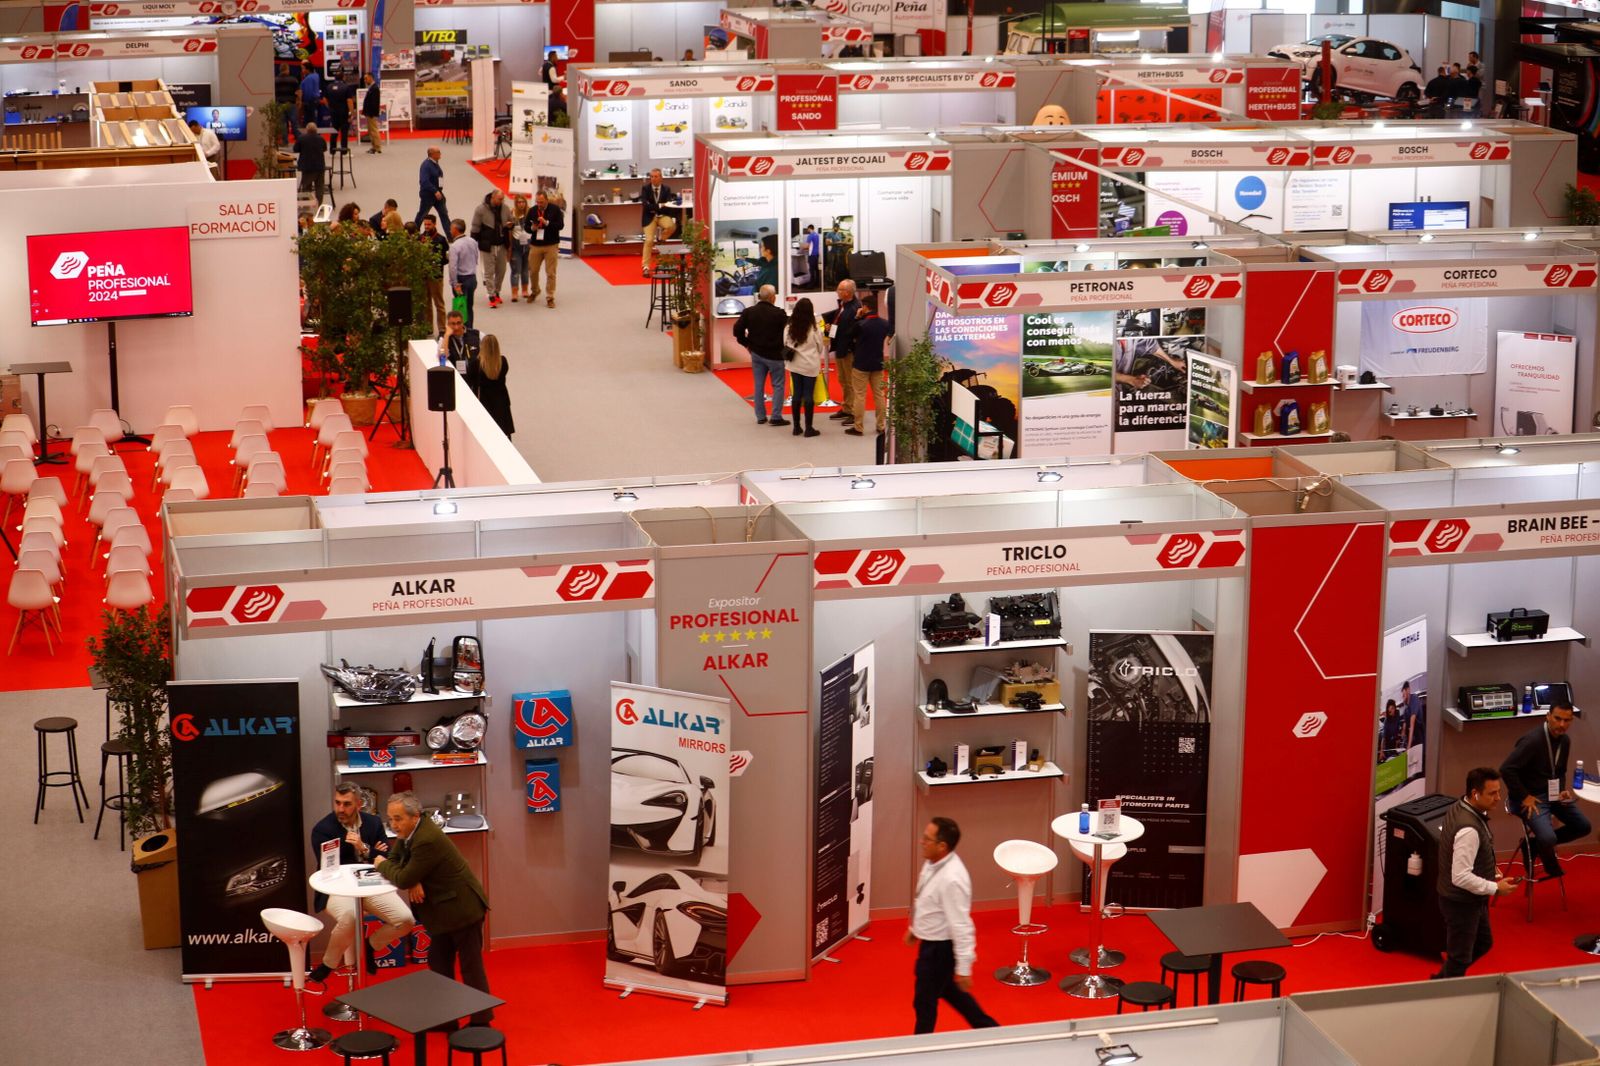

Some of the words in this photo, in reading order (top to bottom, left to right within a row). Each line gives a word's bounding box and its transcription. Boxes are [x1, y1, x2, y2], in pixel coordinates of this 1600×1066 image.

[851, 2, 890, 14] Grupo
[894, 1, 927, 12] Peña
[422, 31, 457, 43] VTEQ
[603, 103, 627, 112] Sando
[664, 100, 690, 111] Sando
[724, 97, 747, 108] Sando
[1191, 150, 1223, 158] BOSCH
[1398, 146, 1429, 154] BOSCH
[796, 157, 835, 166] JALTEST
[851, 156, 885, 164] COJALI
[1052, 171, 1088, 181] EMIUM
[1052, 194, 1080, 203] OSCH
[219, 204, 252, 216] SALA
[257, 203, 276, 215] DE
[191, 218, 276, 235] FORMACIÓN
[87, 262, 125, 278] PEÑA
[1444, 269, 1497, 280] CORTECO
[88, 274, 171, 290] PROFESIONAL
[1070, 281, 1134, 293] PETRONAS
[88, 290, 119, 302] 2024
[947, 318, 992, 326] NOSOTROS
[1027, 315, 1051, 325] Cool
[1399, 313, 1450, 327] CORTECO
[951, 325, 1008, 333] CONDICIONES
[1026, 325, 1077, 337] conseguir
[935, 334, 952, 342] MÁS
[953, 333, 996, 341] EXTREMAS
[1026, 339, 1046, 347] con
[1048, 337, 1082, 346] menos
[1510, 363, 1545, 372] OFRECEMOS
[1517, 371, 1560, 381] TRANQUILIDAD
[1119, 391, 1133, 401] La
[1135, 390, 1171, 401] fuerza
[1119, 404, 1145, 415] para
[1147, 402, 1187, 412] marcar
[1119, 416, 1129, 426] la
[1132, 414, 1187, 425] diferencia
[1508, 517, 1556, 533] BRAIN
[1560, 516, 1588, 529] BEE
[1540, 534, 1563, 544] PEÑA
[1565, 533, 1600, 543] PROFESI
[1003, 544, 1067, 561] TRICLO
[987, 564, 1012, 576] PEÑA
[1015, 563, 1081, 575] PROFESIONAL
[391, 578, 455, 597] ALKAR
[372, 601, 400, 612] PEÑA
[402, 597, 474, 610] PROFESIONAL
[708, 596, 761, 610] Expositor
[670, 608, 799, 630] PROFESIONAL
[703, 652, 769, 671] ALKAR
[1130, 666, 1197, 677] TRICLO
[203, 716, 292, 736] ALKAR
[642, 707, 720, 735] ALKAR
[526, 737, 564, 748] ALKAR
[678, 737, 726, 754] MIRRORS
[188, 928, 280, 945] www.alkar.
[374, 958, 397, 968] KAR
